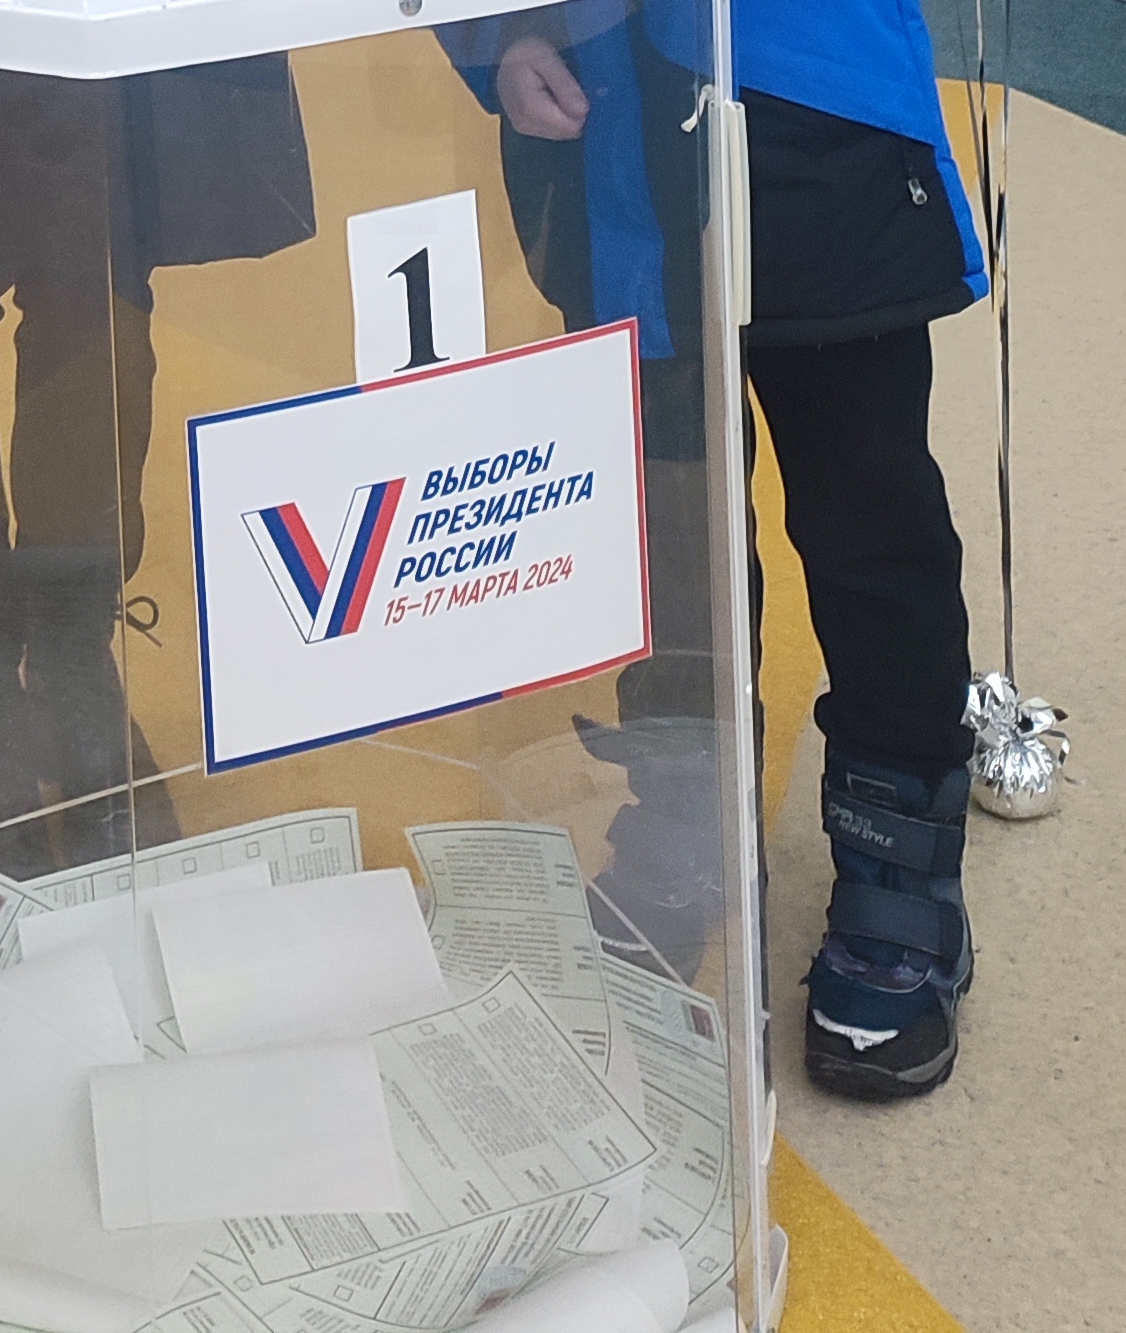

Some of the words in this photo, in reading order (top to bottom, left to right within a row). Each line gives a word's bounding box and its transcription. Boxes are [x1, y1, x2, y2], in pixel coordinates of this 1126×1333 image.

[388, 247, 450, 373] 1
[421, 441, 556, 501] ВЫБОРЫ
[407, 471, 594, 545] ПРЕЗИДЕНТА
[393, 531, 518, 589] РОССИИ
[446, 569, 520, 611] МАРТА
[523, 555, 573, 593] 2024
